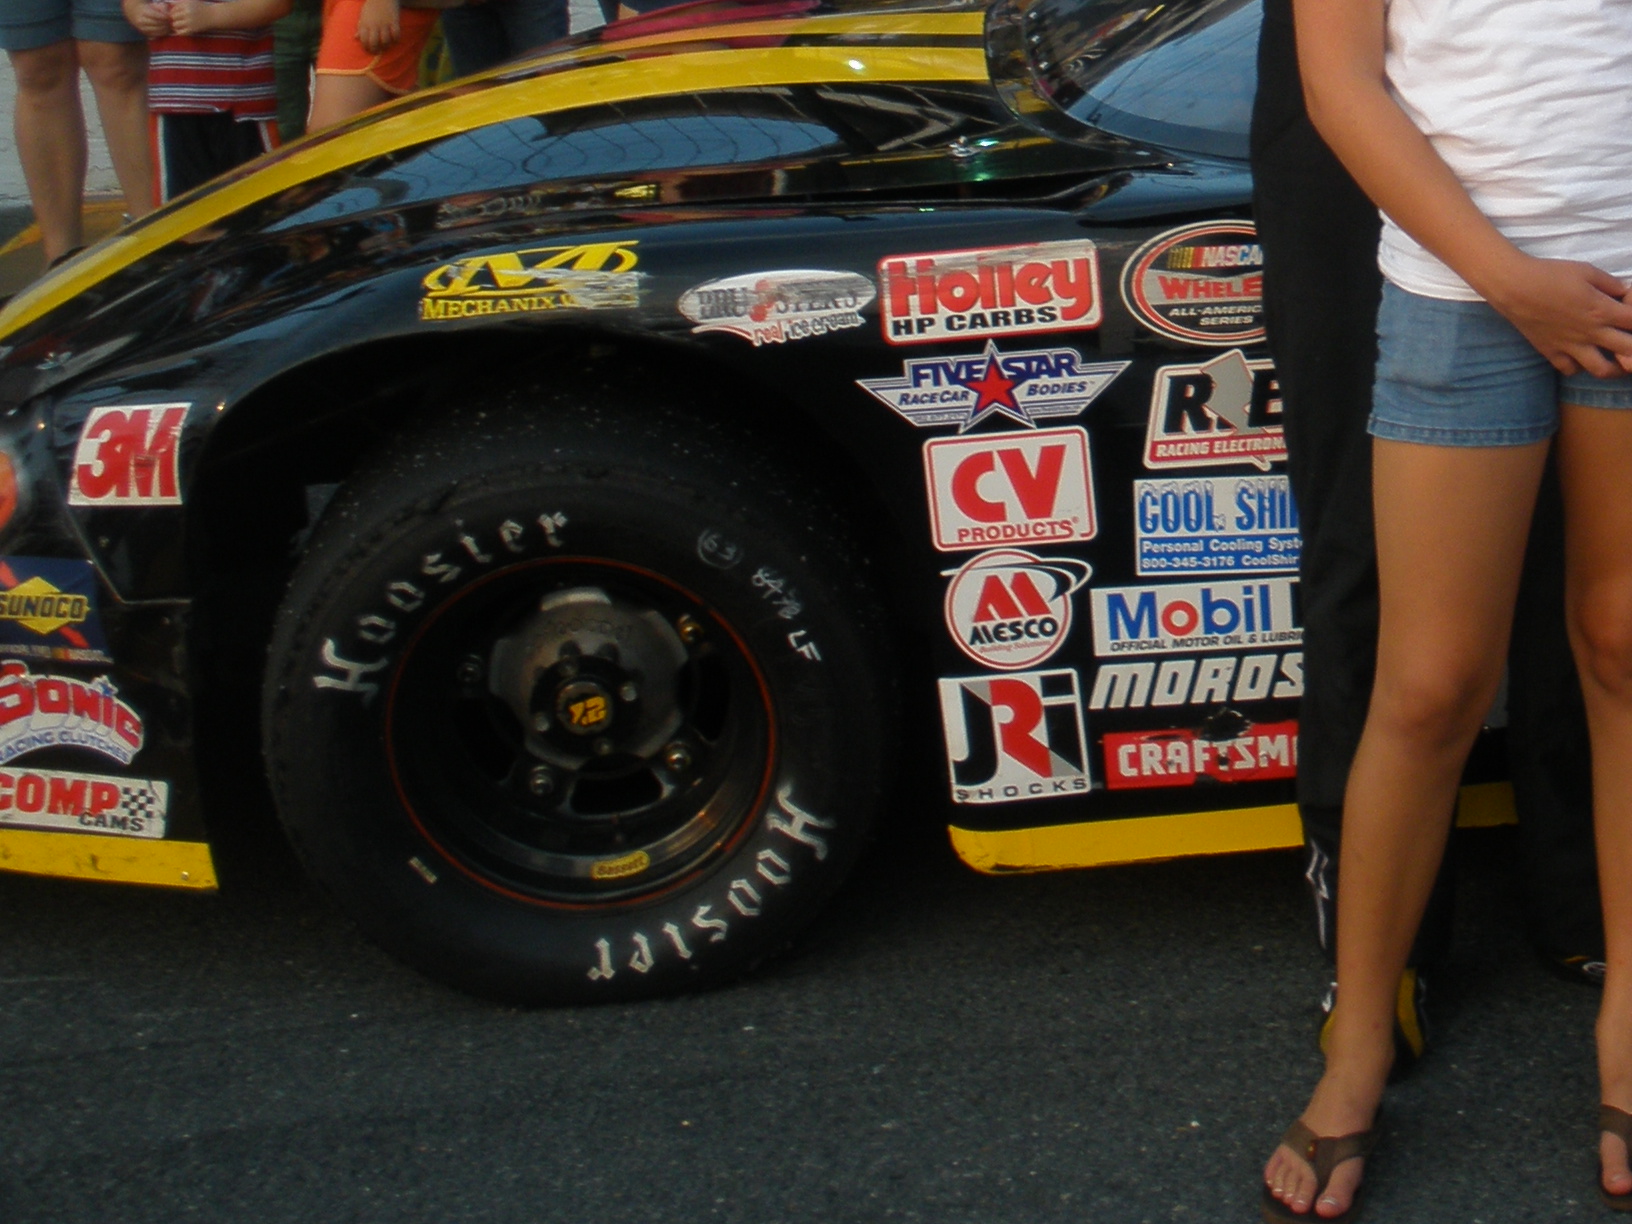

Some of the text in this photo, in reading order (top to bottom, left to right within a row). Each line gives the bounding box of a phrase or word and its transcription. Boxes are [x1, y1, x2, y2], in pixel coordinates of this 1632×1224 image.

[1203, 244, 1264, 267] NASCA
[887, 257, 1093, 321] Holley
[1157, 275, 1263, 300] WHELE
[422, 293, 557, 321] MECHANIX
[1168, 305, 1264, 317] ALL-AMERIC
[891, 306, 1059, 336] HP CARBS
[1199, 316, 1254, 326] SERIES
[911, 352, 1078, 389] FIVE STAR
[1026, 381, 1088, 397] BODIES
[77, 407, 187, 499] 3M
[1156, 436, 1287, 457] RACING ELECTRON
[951, 444, 1067, 524] CV
[1138, 480, 1226, 535] COOL
[957, 520, 1075, 542] PRODUCTS
[1142, 539, 1204, 554] Personal
[1209, 538, 1263, 553] Cooling
[1241, 554, 1300, 567] CoolShir
[1106, 584, 1273, 641] Mobil
[969, 617, 1059, 646] MESCO
[1110, 640, 1167, 653] OFFICIAL
[1171, 637, 1219, 650] MOTOR
[1222, 634, 1243, 646] OIL
[1088, 651, 1305, 710] MOROS
[58, 730, 131, 760] CLUTCHES
[1117, 734, 1298, 777] CRAFTSM
[955, 778, 1088, 801] SHOCKS
[79, 811, 145, 832] CAMS
